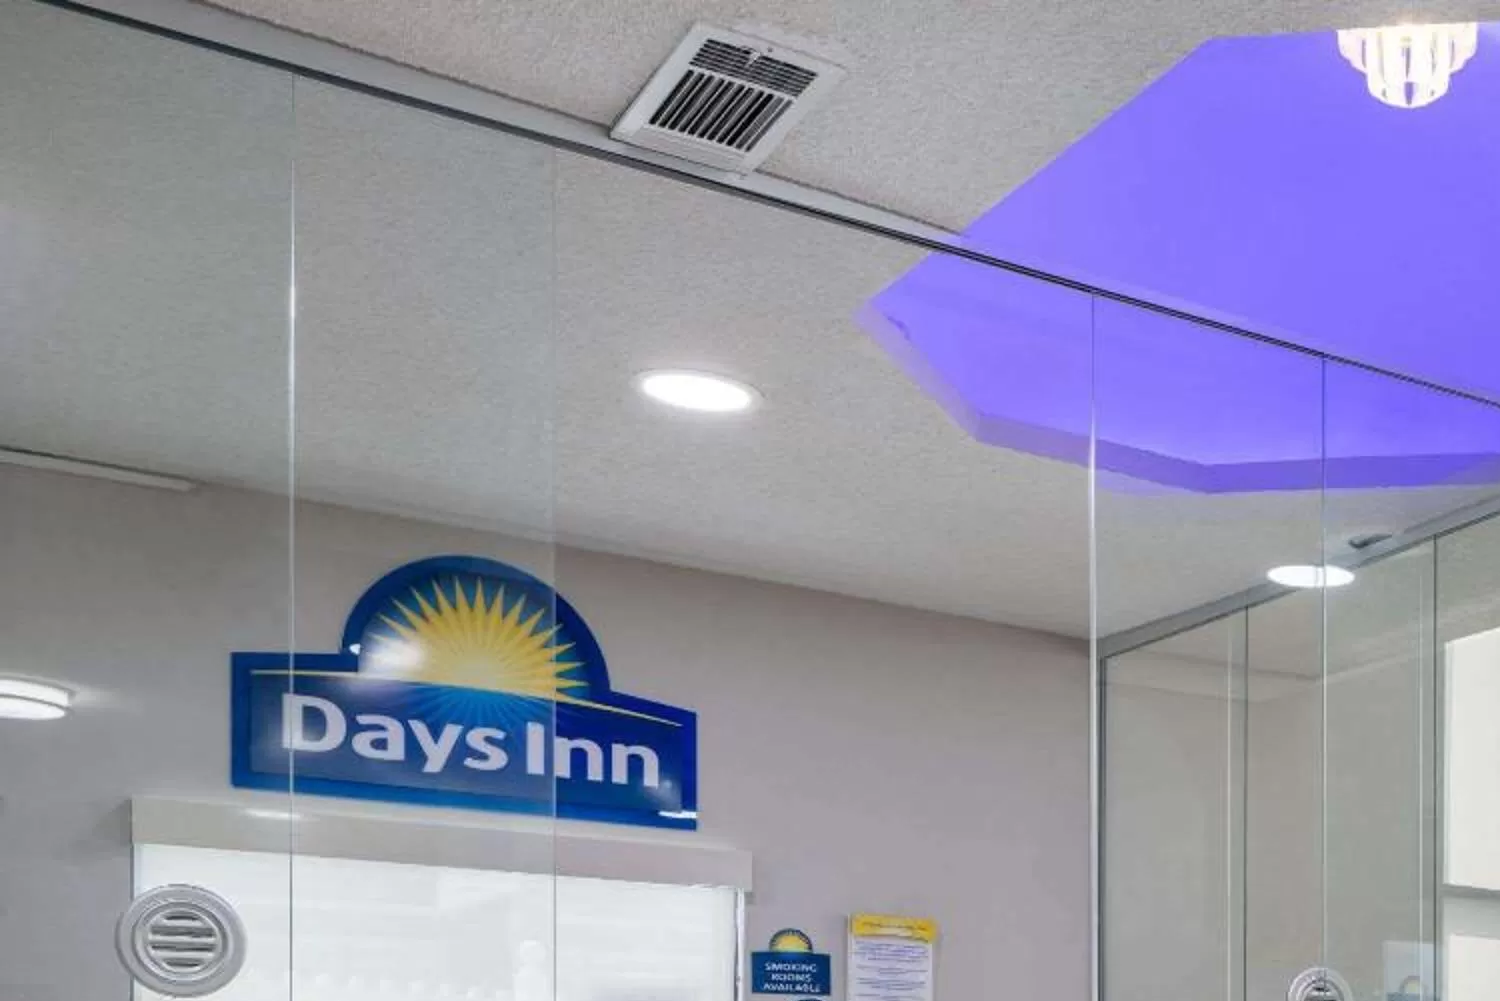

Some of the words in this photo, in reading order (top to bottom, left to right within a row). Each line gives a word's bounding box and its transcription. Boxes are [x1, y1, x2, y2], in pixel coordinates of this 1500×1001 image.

[281, 692, 510, 774] Days
[525, 721, 661, 788] Inn
[764, 961, 817, 973] SMOKING
[771, 972, 812, 983] ROOMS
[763, 982, 821, 993] AVAILABLE
